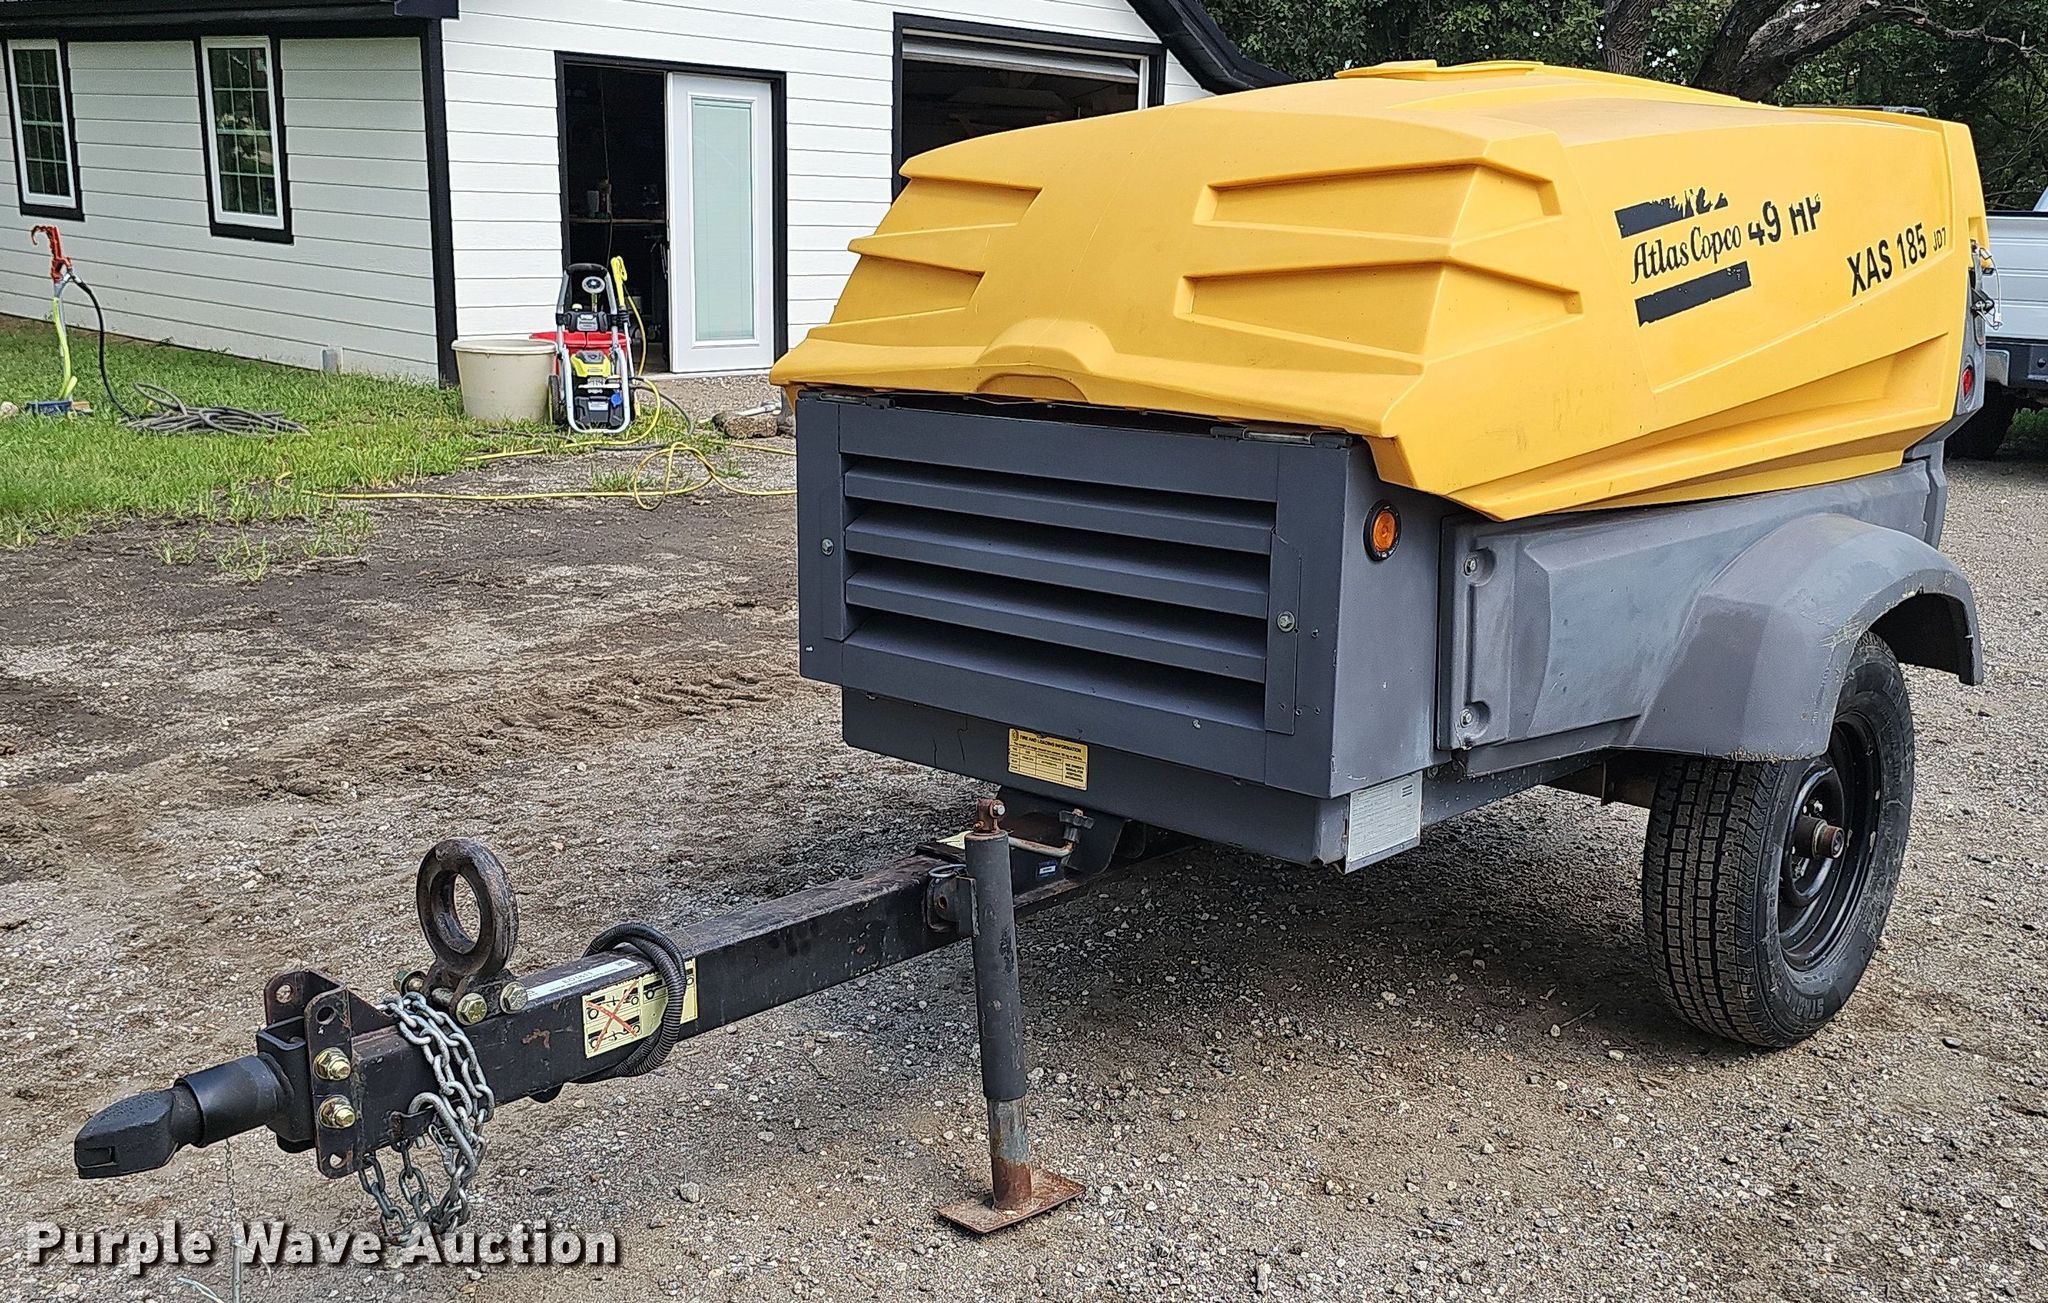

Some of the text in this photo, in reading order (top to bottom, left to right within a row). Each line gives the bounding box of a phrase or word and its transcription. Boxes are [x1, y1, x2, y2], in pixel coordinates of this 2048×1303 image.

[1747, 193, 1821, 246] 49 HP
[1631, 226, 1742, 285] Atlas Copco
[1846, 222, 1947, 297] XAS 185 JD7
